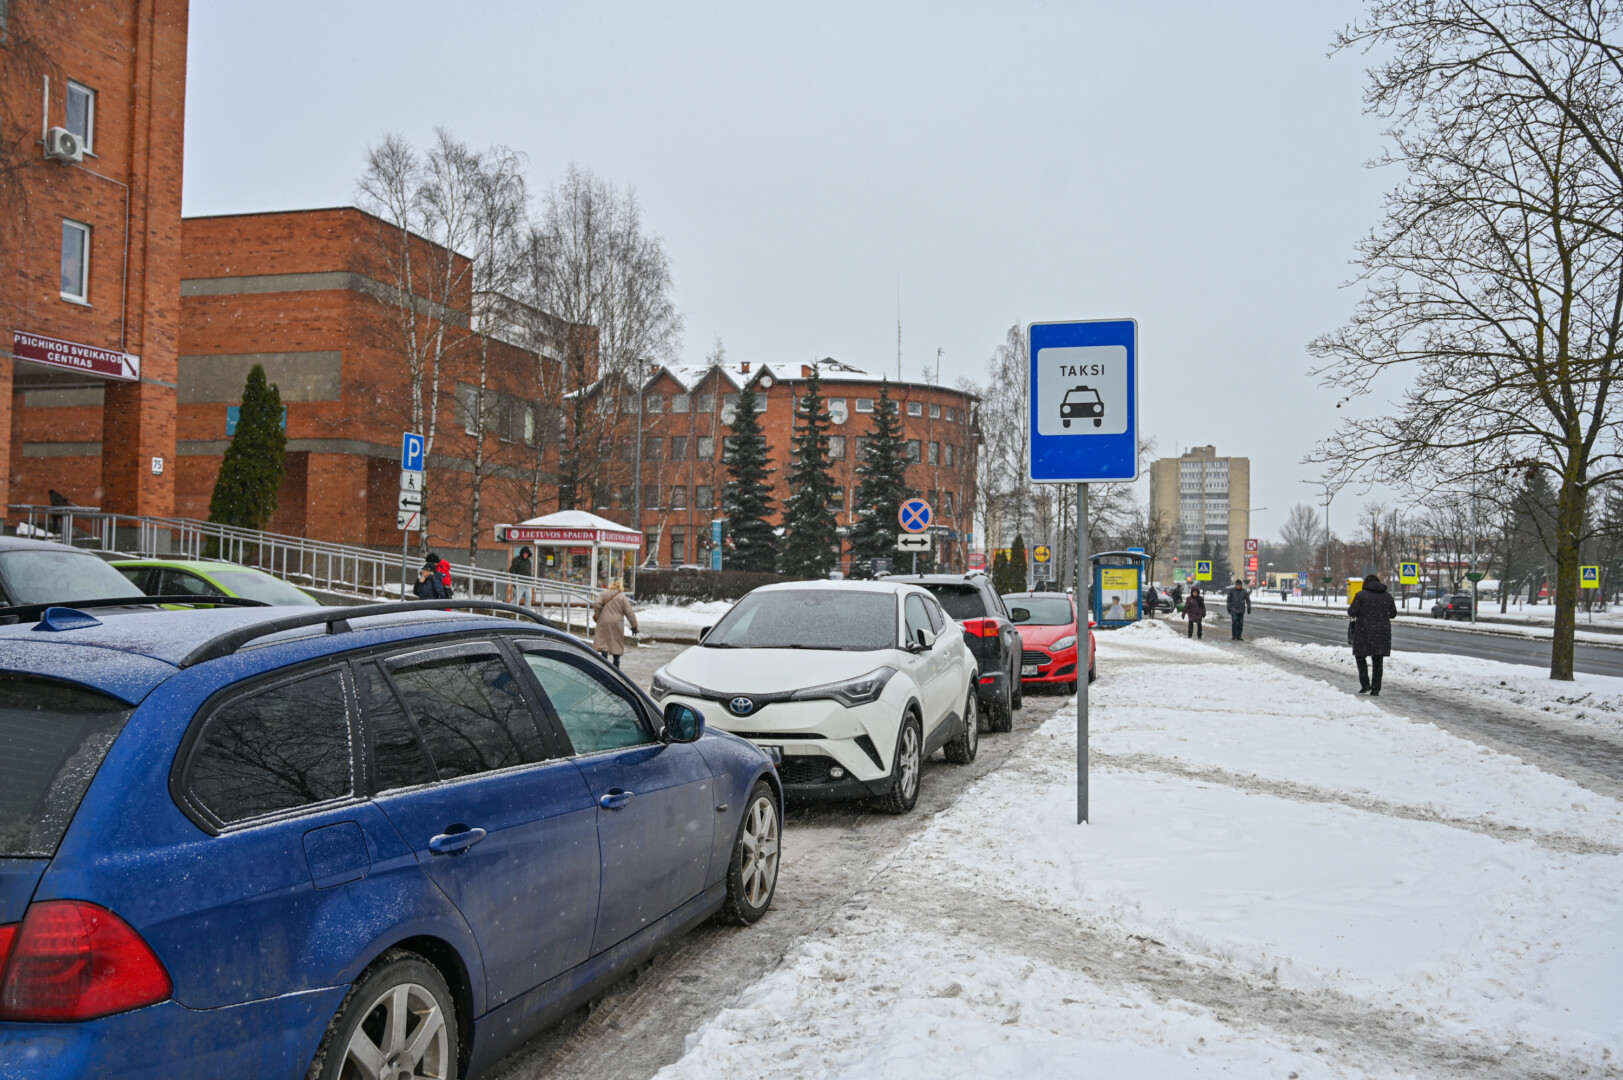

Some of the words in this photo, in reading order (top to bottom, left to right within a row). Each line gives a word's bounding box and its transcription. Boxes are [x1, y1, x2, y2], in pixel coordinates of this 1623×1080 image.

[14, 334, 69, 354] PSICHIKOS
[71, 345, 123, 364] SVEIKATOS
[47, 352, 93, 368] CENTRAS
[1059, 364, 1105, 377] TAKSI
[408, 438, 420, 467] P
[153, 459, 162, 470] 75
[521, 531, 561, 540] LIETUVOS
[563, 531, 594, 540] SPAUDA
